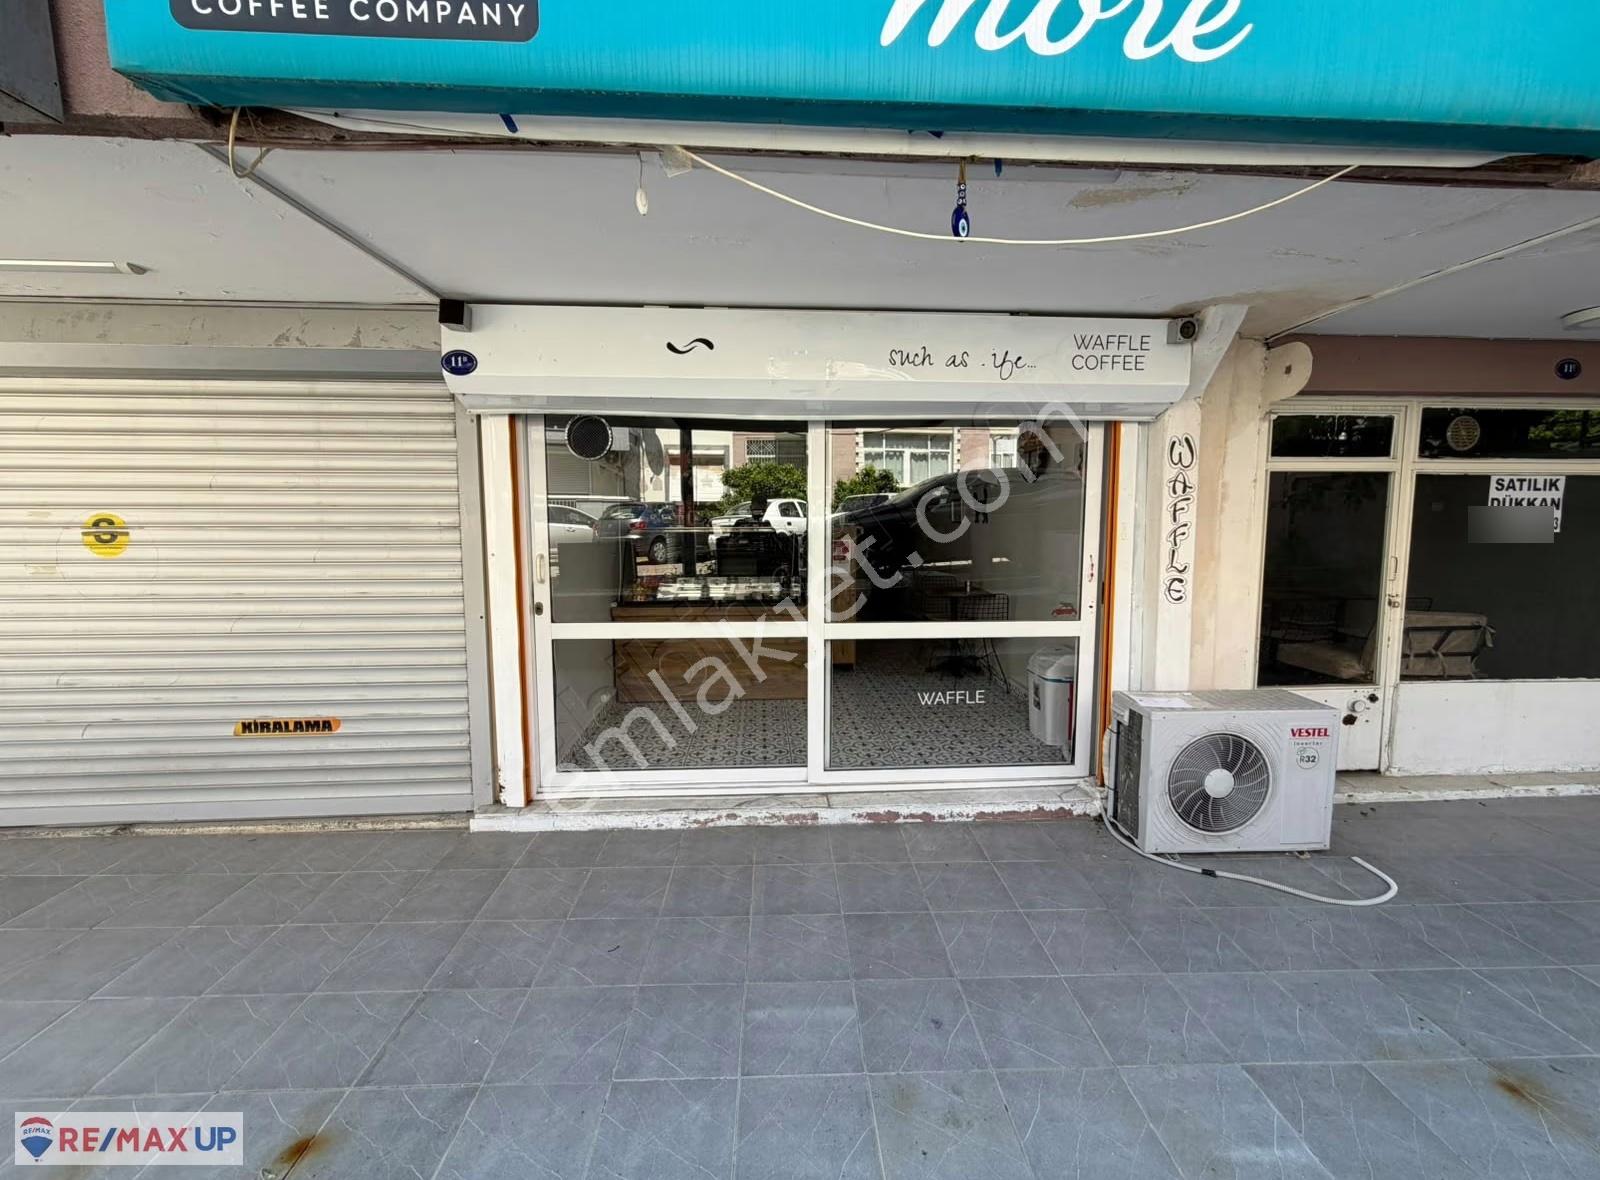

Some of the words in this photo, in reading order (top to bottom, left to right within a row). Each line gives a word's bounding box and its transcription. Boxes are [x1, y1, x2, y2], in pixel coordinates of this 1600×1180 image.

[350, 0, 525, 27] COMPANY
[1073, 333, 1152, 352] WAFFLE
[887, 345, 934, 368] such
[945, 350, 970, 369] as
[1071, 354, 1146, 371] COFFEE
[1494, 477, 1561, 492] SATILIK
[1166, 434, 1195, 603] WAFFLE
[917, 689, 986, 706] WAFFLE
[1290, 727, 1330, 738] VESTEL
